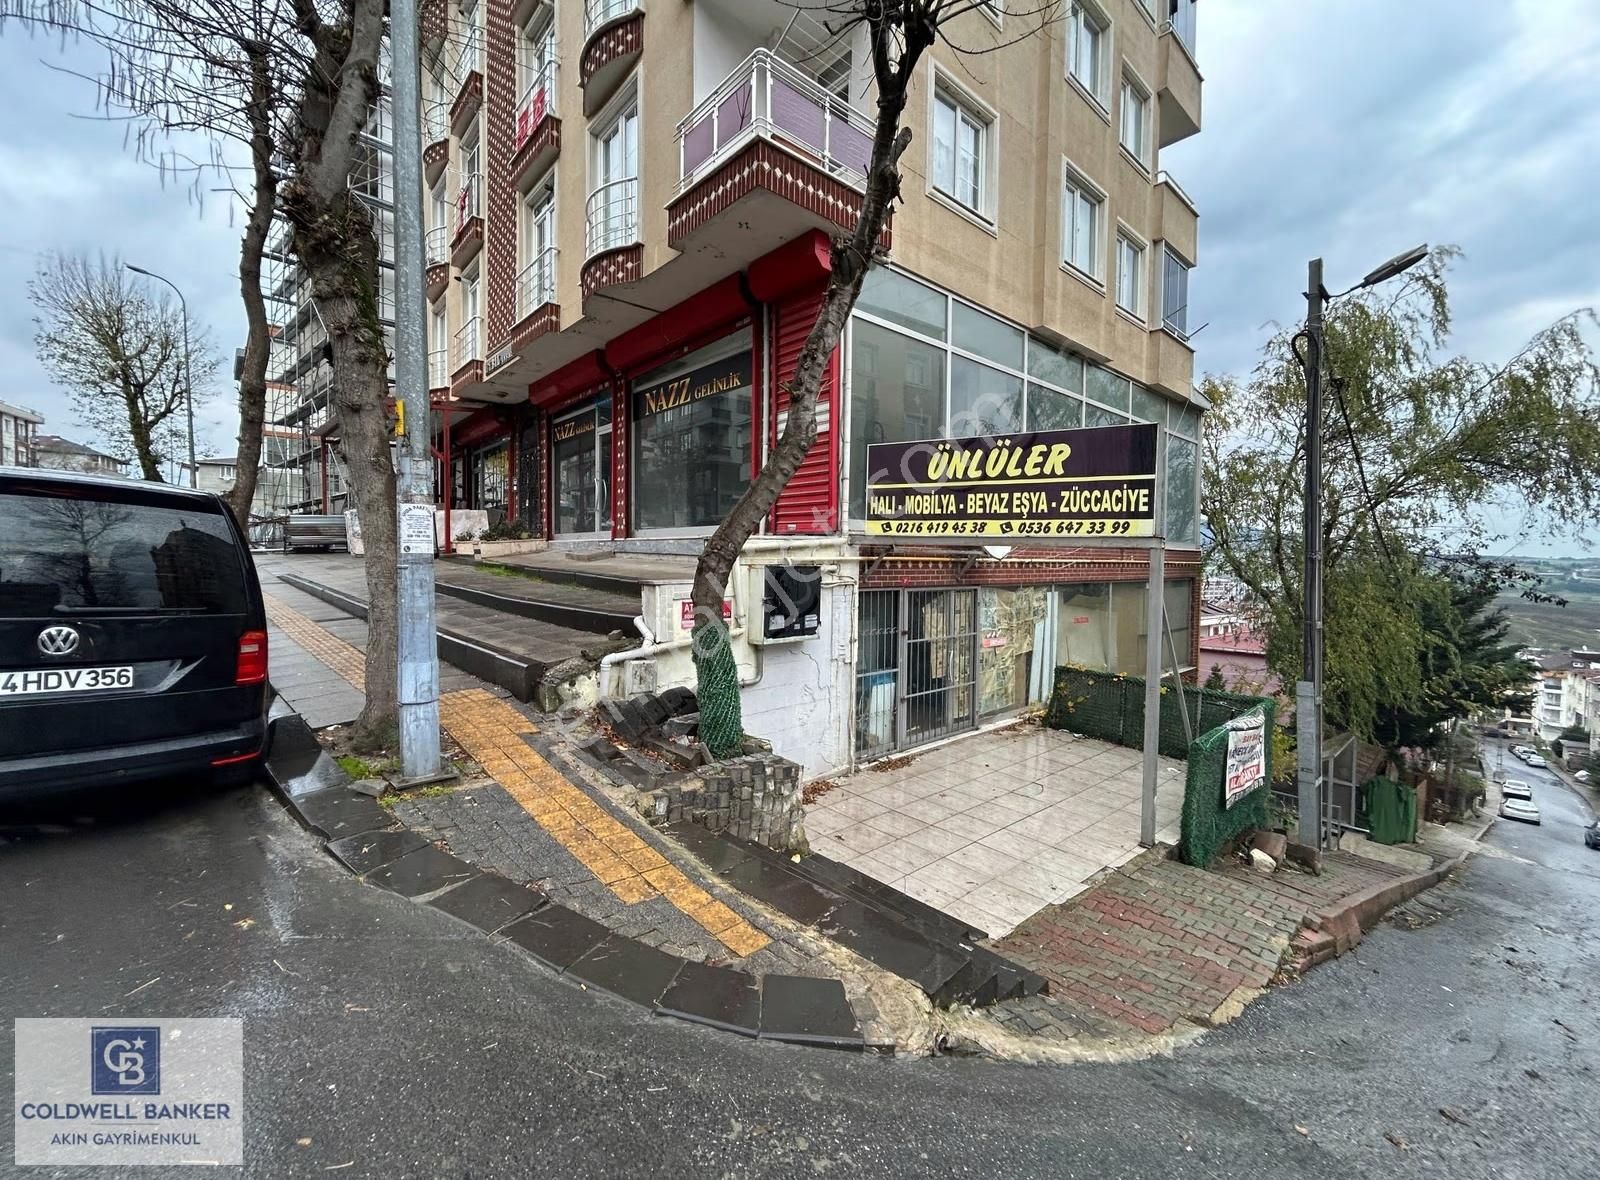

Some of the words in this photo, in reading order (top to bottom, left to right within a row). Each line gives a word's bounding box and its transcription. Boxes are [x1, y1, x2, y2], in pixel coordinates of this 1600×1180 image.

[645, 378, 690, 415] NAZZ
[694, 372, 741, 399] GELİNLİK
[554, 421, 575, 441] NAZZ
[927, 438, 1072, 481] ÜNLÜLER
[870, 495, 896, 515] HALI
[905, 489, 957, 515] MOBİLYA
[967, 493, 1009, 514] BEYAZ
[1012, 491, 1049, 518] EŞYA
[1060, 483, 1149, 513] ZÜCCACİYE
[895, 521, 923, 533] 0216
[926, 521, 949, 533] 419
[951, 521, 967, 533] 45
[969, 521, 988, 533] 38
[1017, 520, 1052, 534] 0536
[1055, 520, 1084, 534] 647
[1086, 520, 1107, 534] 33
[1110, 520, 1131, 534] 99
[22, 670, 82, 691] HDV
[85, 667, 131, 688] 356
